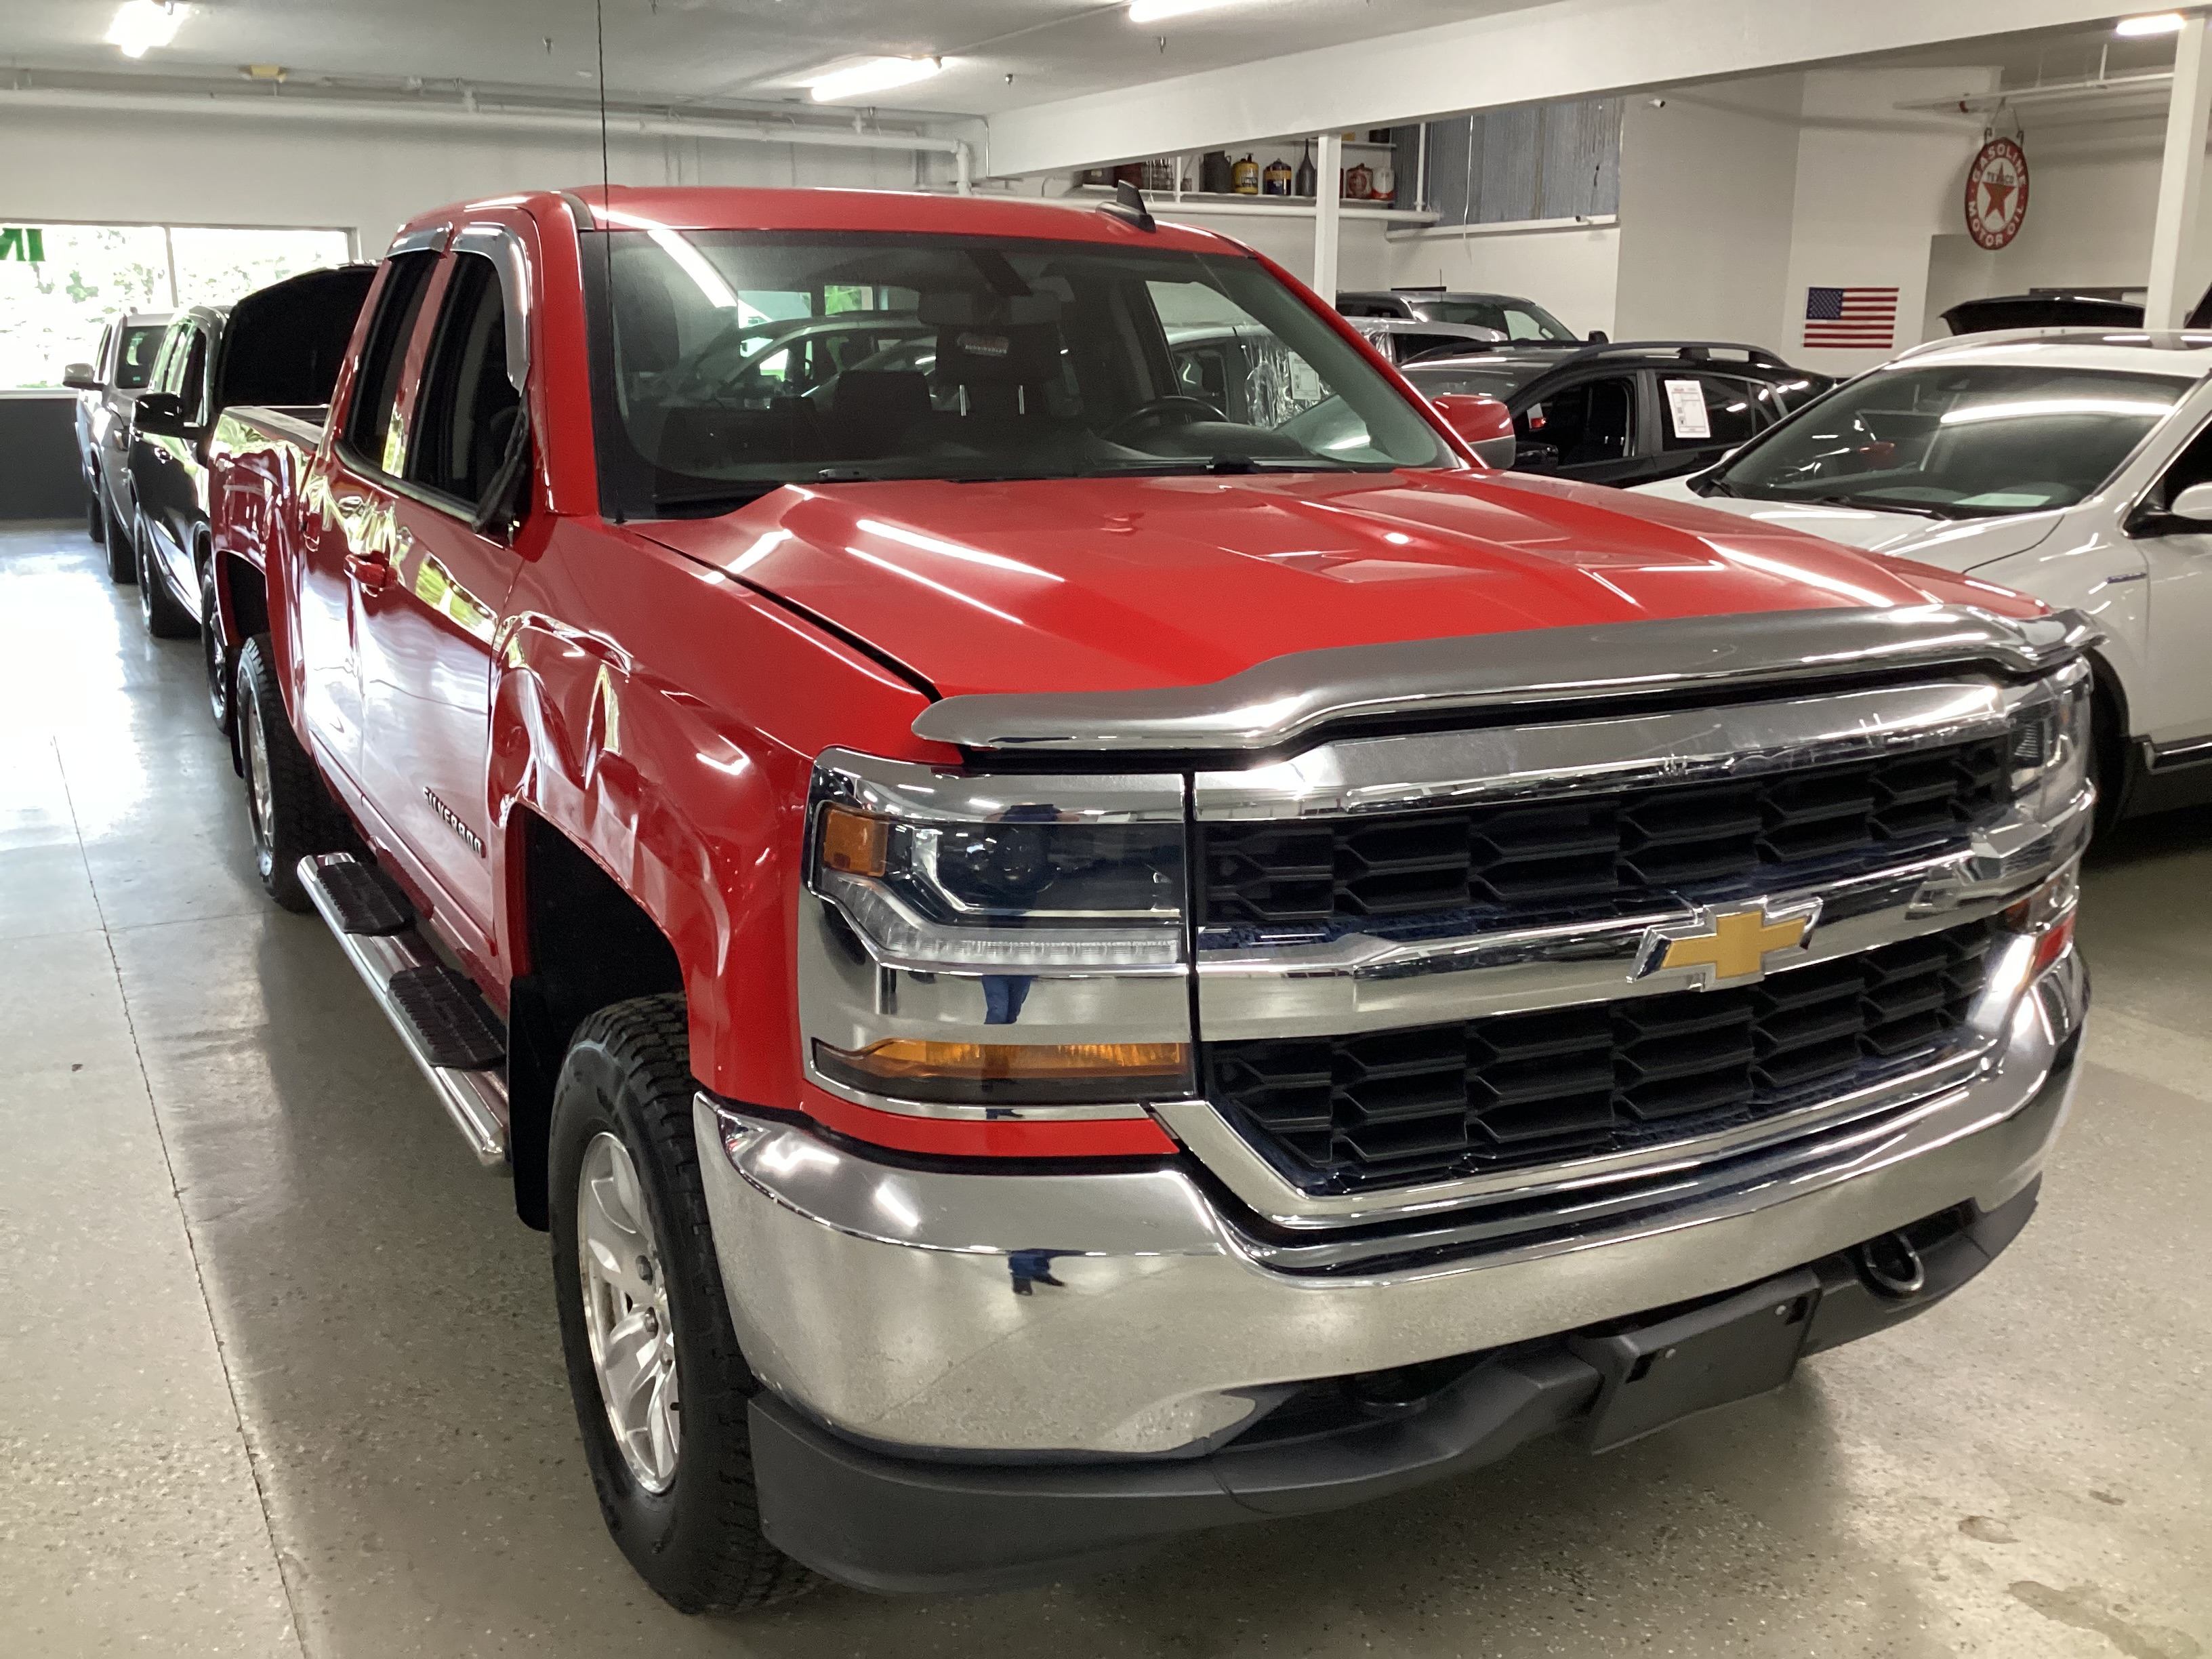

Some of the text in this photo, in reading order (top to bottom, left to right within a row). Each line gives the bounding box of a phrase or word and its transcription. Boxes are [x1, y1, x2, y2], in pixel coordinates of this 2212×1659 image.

[1972, 143, 2026, 186] GASOLINE
[1968, 201, 2024, 247] MOTOR OIL
